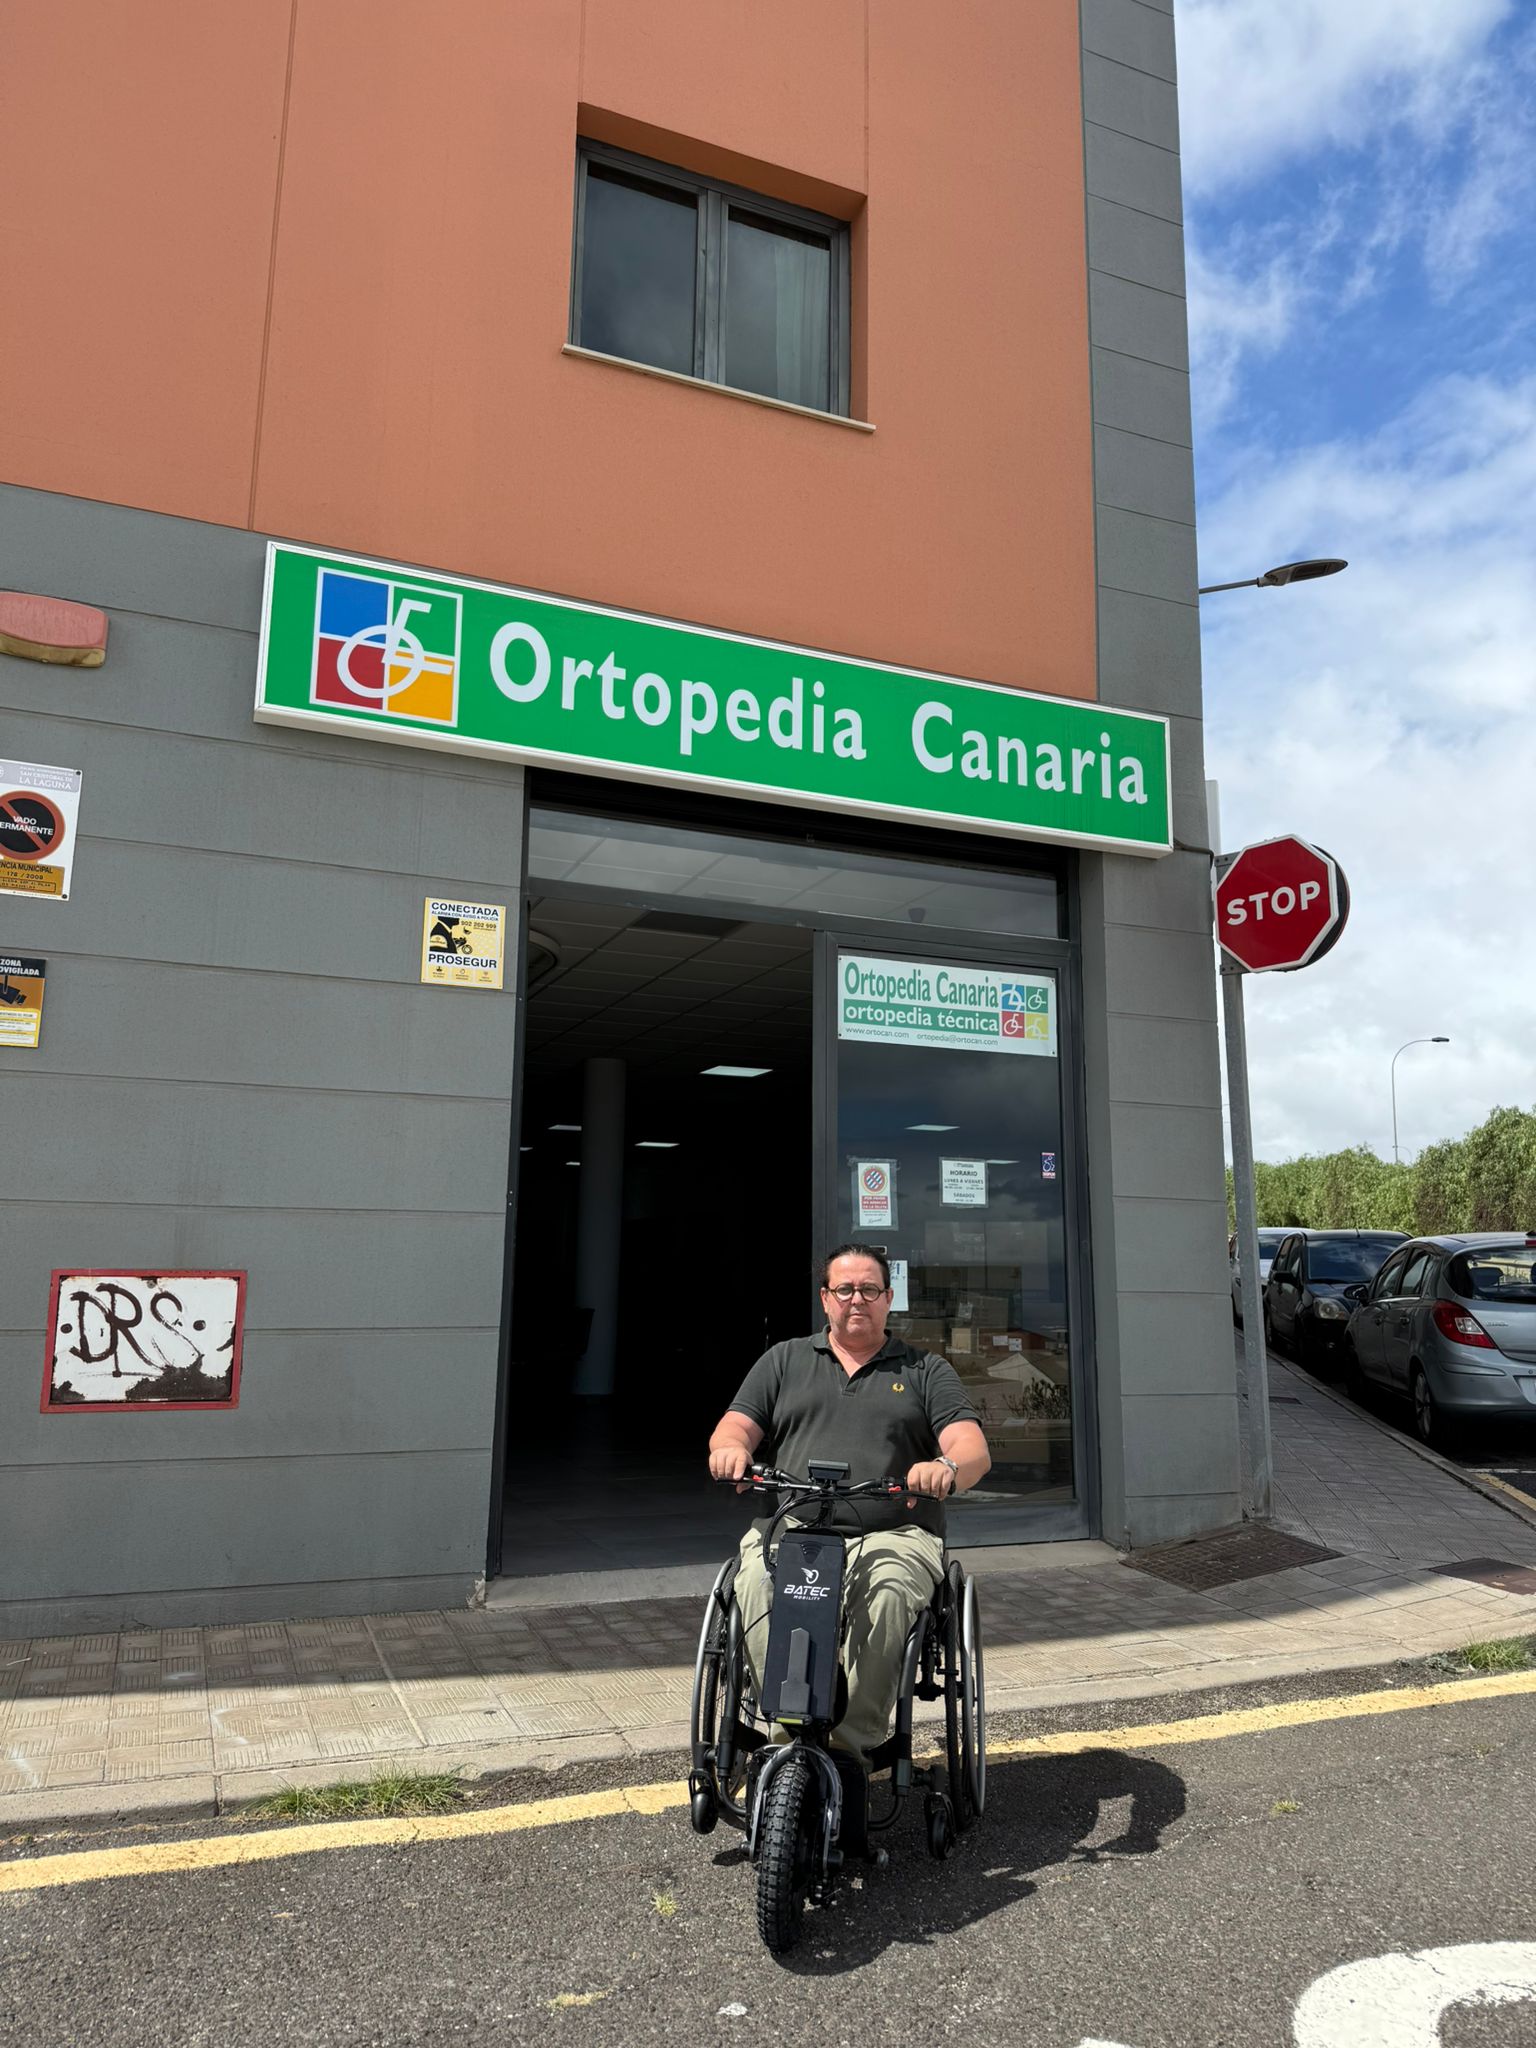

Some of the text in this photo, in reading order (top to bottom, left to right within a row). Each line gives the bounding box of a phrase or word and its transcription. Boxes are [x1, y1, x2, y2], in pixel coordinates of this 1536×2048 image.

[489, 621, 1148, 804] Ortopedia Canaria
[19, 776, 72, 790] LA LAGUNA
[13, 816, 37, 825] VADO
[0, 861, 53, 874] NCIA MUNICIPAL
[431, 902, 498, 916] CONECTADA
[1226, 880, 1321, 926] STOP
[0, 958, 21, 967] ZONA
[428, 953, 497, 968] PROSEGUR
[844, 961, 999, 1008] Ortopedia Canaria
[845, 1004, 999, 1032] ortopedia técnica
[845, 1027, 910, 1039] www.ortocan.com
[783, 1584, 830, 1597] BATEC
